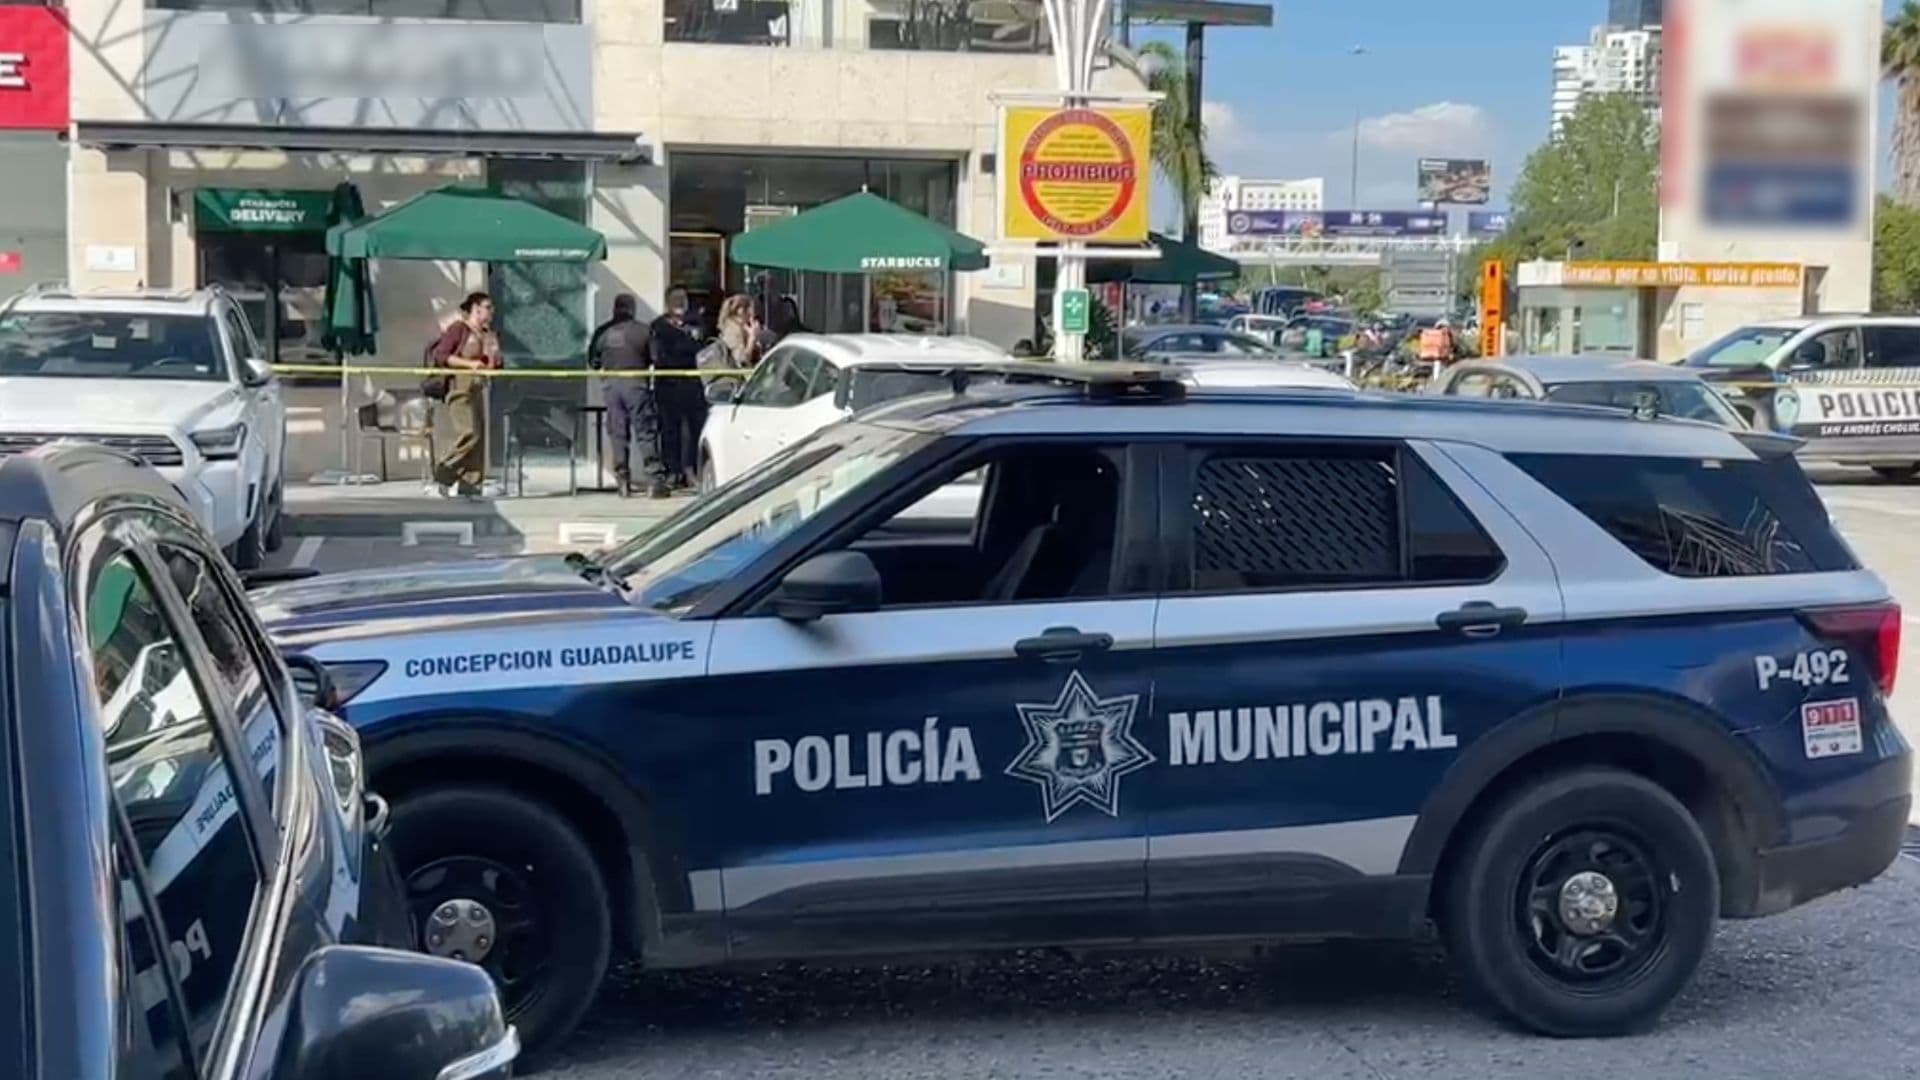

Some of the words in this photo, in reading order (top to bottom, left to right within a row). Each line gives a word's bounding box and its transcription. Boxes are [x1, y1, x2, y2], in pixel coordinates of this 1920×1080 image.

[1022, 162, 1134, 179] PROHIBIDO
[230, 208, 305, 223] DELIVERY
[860, 255, 941, 269] STARBUCKS
[1821, 424, 1840, 436] SAN
[405, 649, 553, 678] CONCEPCION
[560, 640, 696, 668] GUADALUPE
[1755, 649, 1850, 691] P-492
[754, 716, 981, 796] POLICÍA
[1168, 695, 1458, 767] MUNICIPAL
